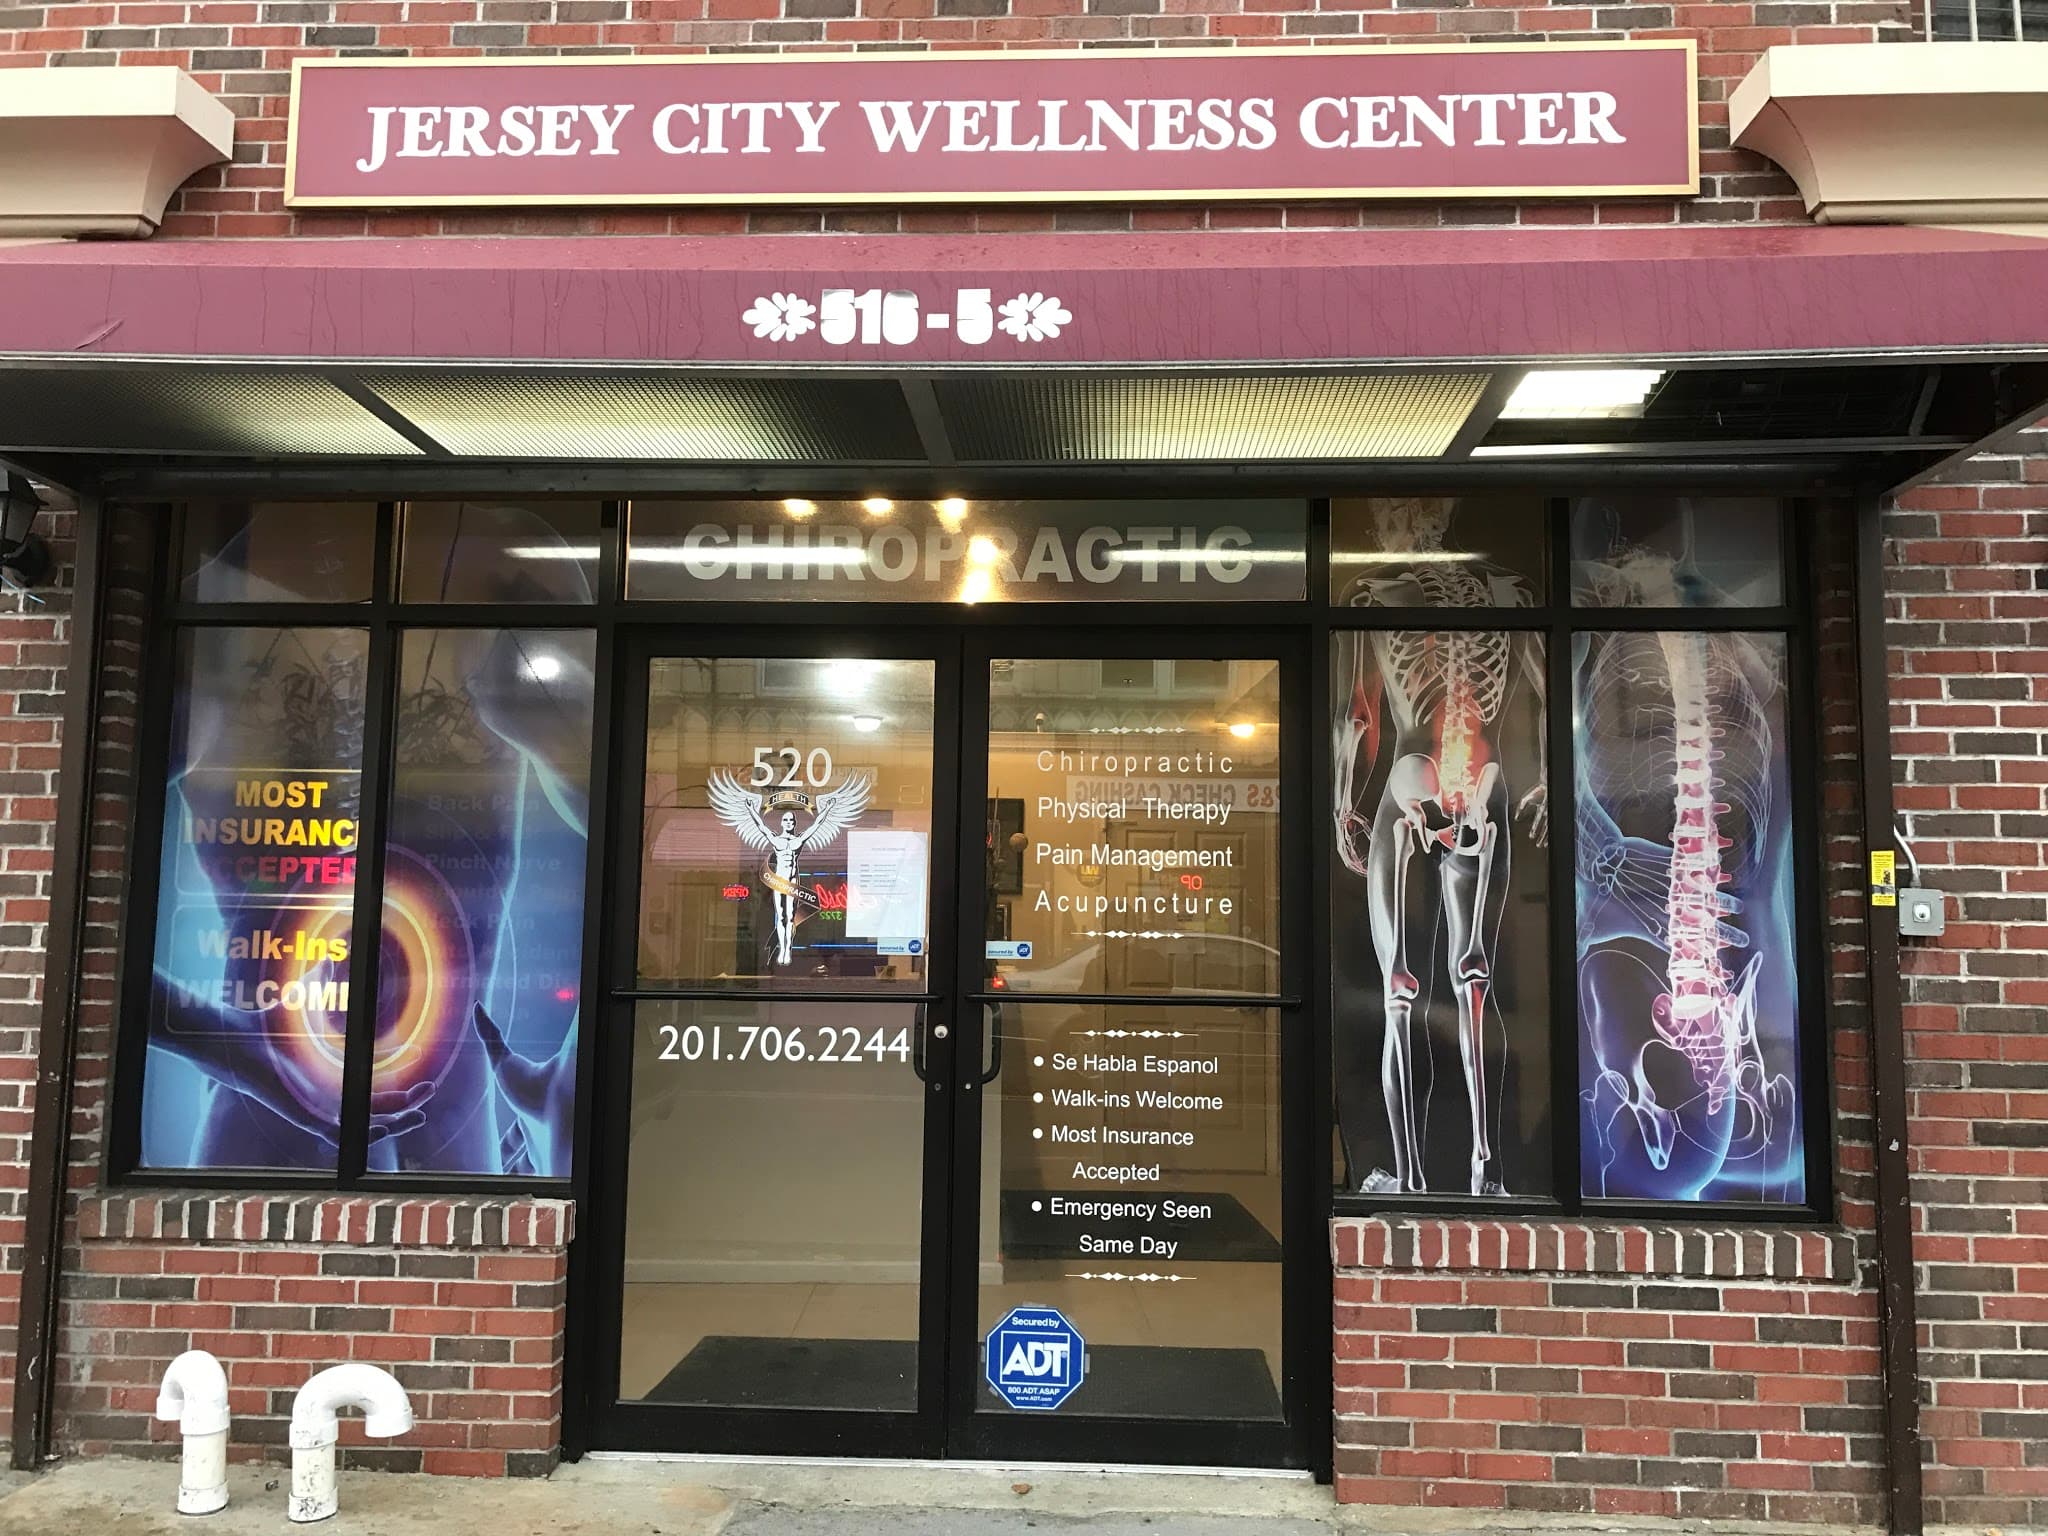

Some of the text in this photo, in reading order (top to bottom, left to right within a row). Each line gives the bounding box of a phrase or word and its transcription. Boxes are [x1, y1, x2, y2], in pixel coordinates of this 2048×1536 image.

[355, 91, 1626, 173] JERSEY CITY WELLNESS CENTER
[683, 524, 1253, 584] CHIROPRACTIC
[750, 747, 832, 787] 520
[1037, 750, 1233, 777] Chiropractic
[235, 781, 328, 808] MOST
[772, 793, 808, 804] HEALTH
[1038, 796, 1231, 826] Physical Therapy
[1036, 842, 1233, 872] Pain Management
[1034, 890, 1233, 918] Acupuncture
[198, 929, 348, 962] Walk-Ins
[658, 1025, 910, 1063] 201.706.2244
[1052, 1052, 1218, 1077] Se Habla Espanol
[1051, 1088, 1223, 1110] Walk-ins Welcome
[1051, 1124, 1194, 1146] Most Insurance
[1072, 1162, 1160, 1184] Accepted
[1051, 1197, 1212, 1221] Emergency Seen
[1079, 1234, 1178, 1259] Same Day
[1012, 1316, 1060, 1329] Secured by
[1002, 1341, 1068, 1377] ADT
